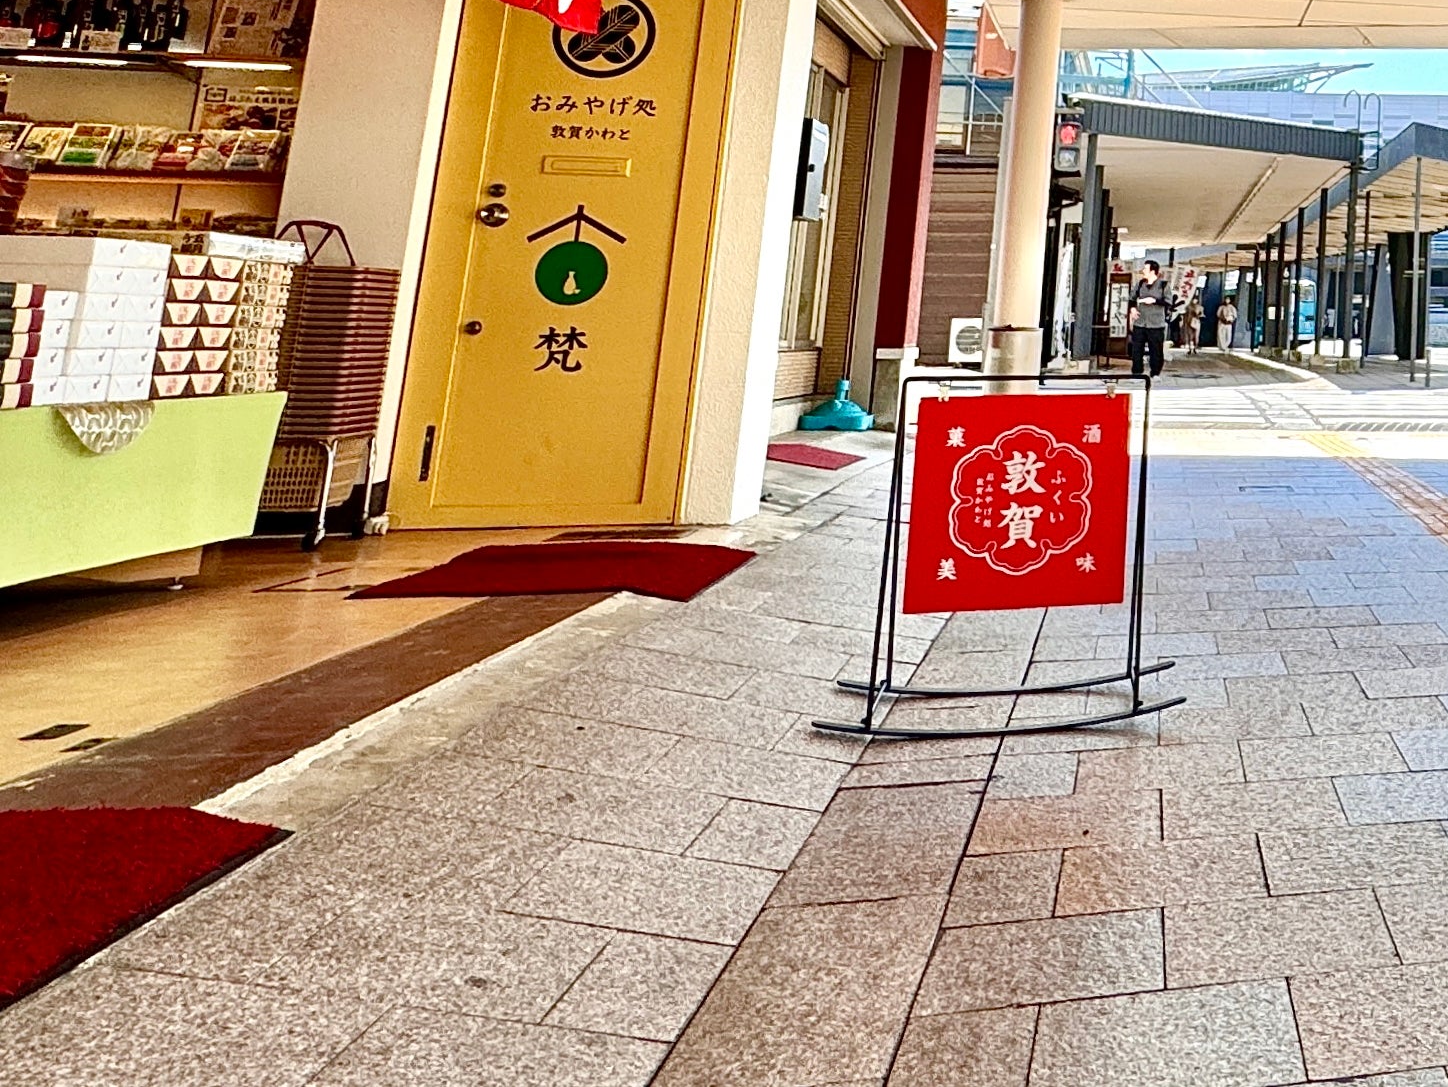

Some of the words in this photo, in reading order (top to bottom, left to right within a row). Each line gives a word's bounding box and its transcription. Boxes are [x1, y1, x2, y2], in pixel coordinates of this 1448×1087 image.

[530, 94, 657, 117] おみやげ処
[550, 125, 631, 141] 敦賀かわと
[533, 326, 588, 373] 梵
[945, 426, 967, 448] 菓
[1081, 424, 1101, 444] 酒
[997, 450, 1047, 550] 敦賀
[1050, 470, 1066, 523] ふくい
[936, 558, 957, 581] 美
[1075, 552, 1097, 573] 味
